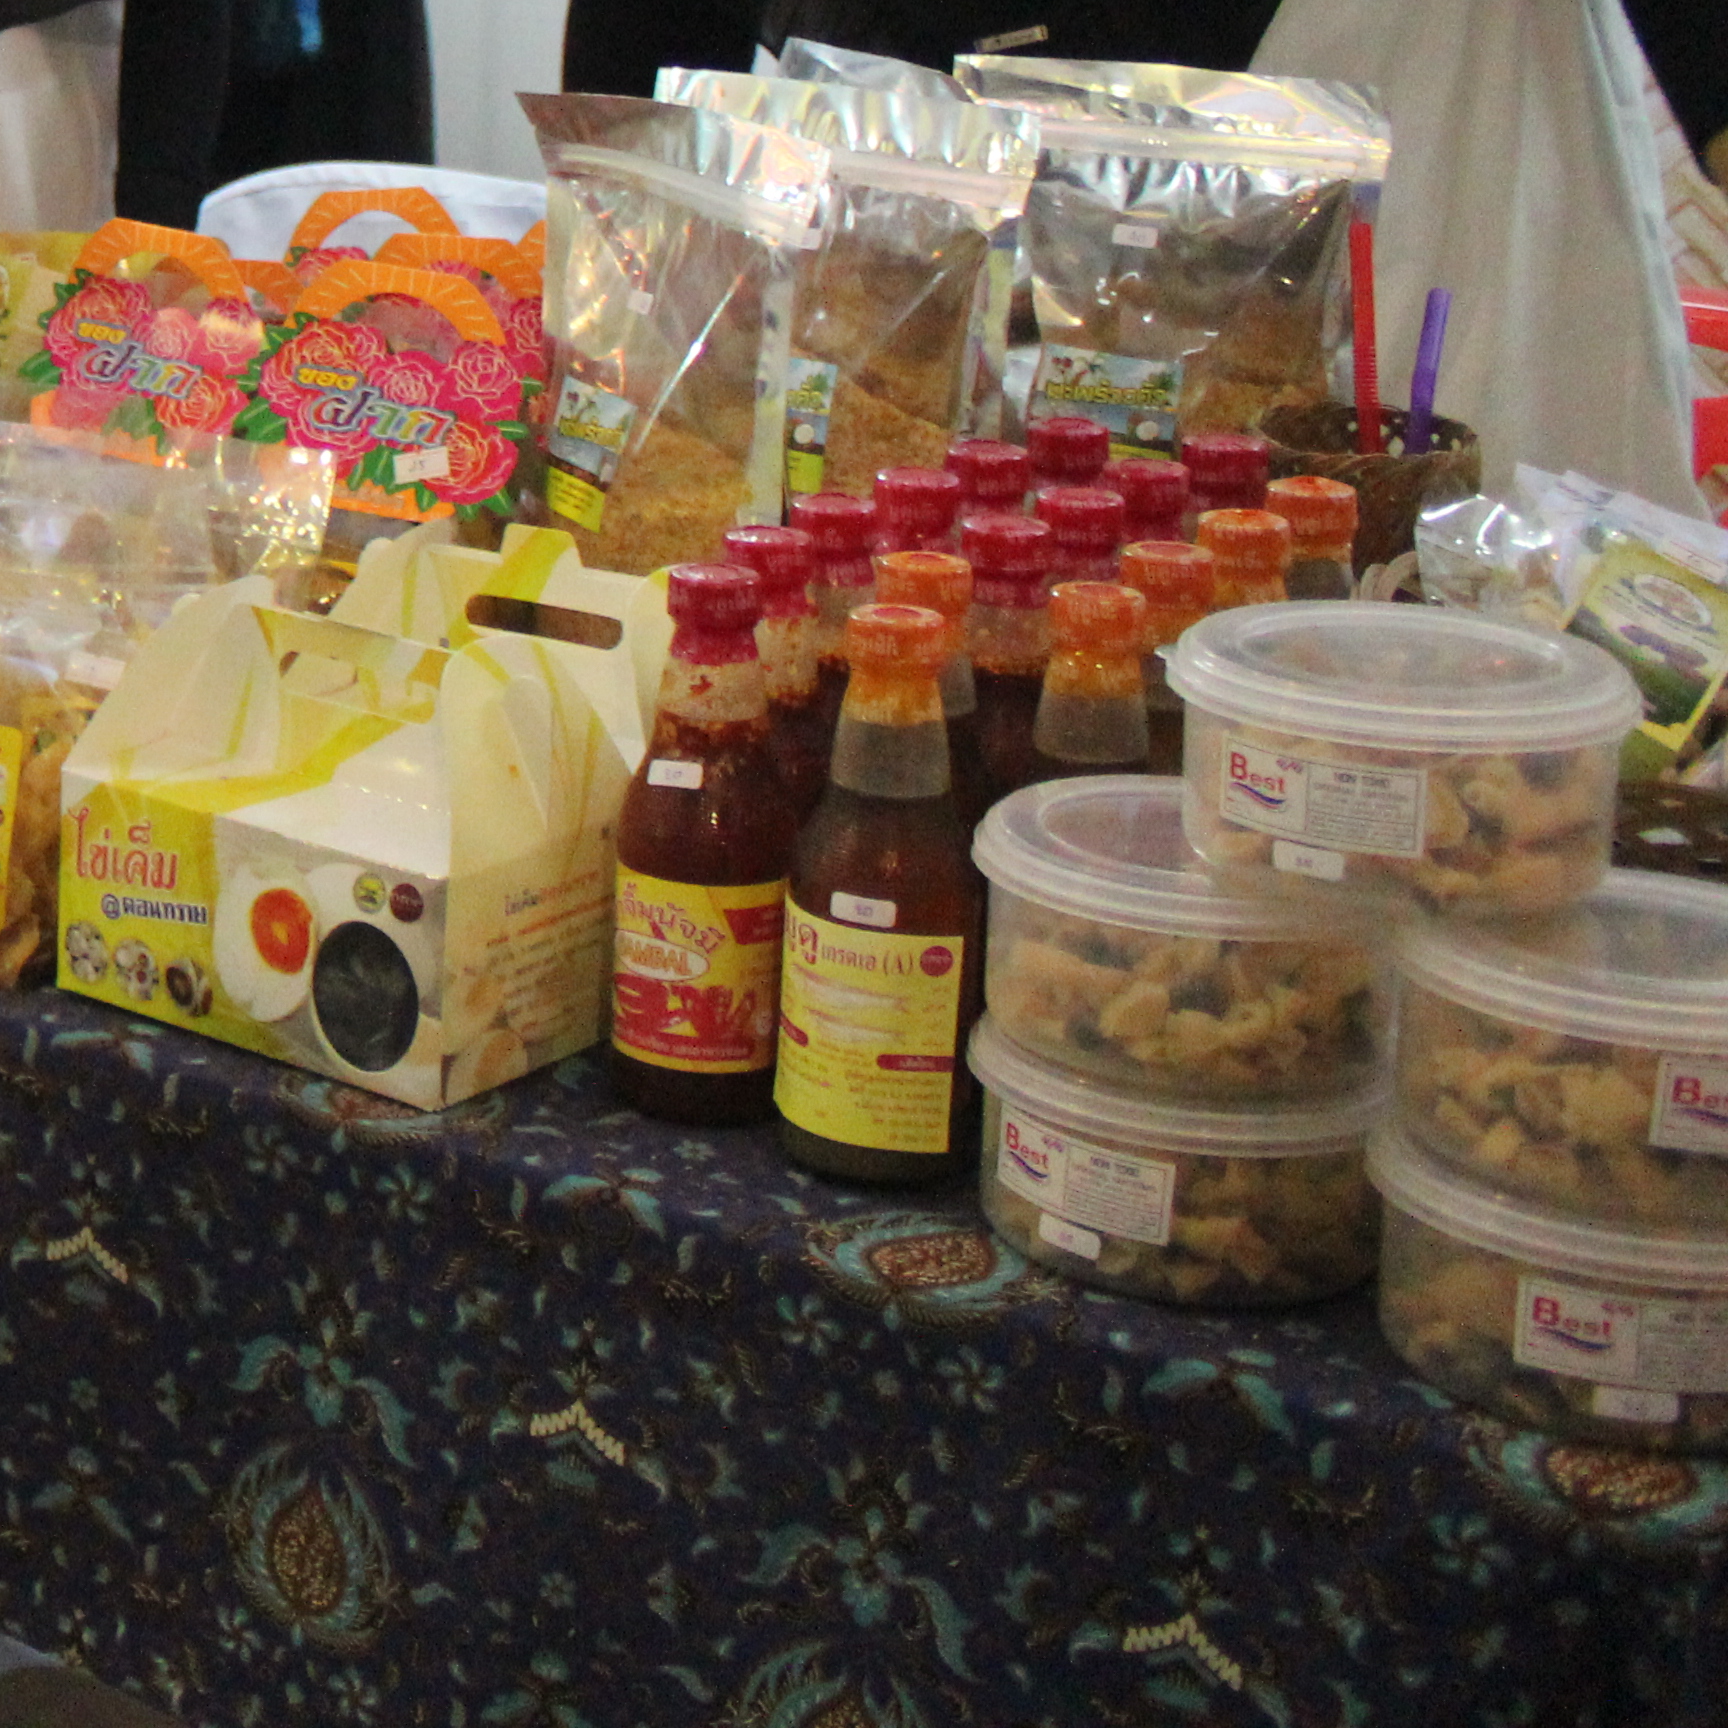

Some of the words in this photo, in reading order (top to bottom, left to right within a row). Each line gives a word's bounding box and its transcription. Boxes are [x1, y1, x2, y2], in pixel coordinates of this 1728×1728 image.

[77, 322, 126, 343] ของ
[84, 344, 200, 398] ฝาก
[296, 367, 358, 391] ของ
[311, 390, 453, 446] ฝาก
[1230, 751, 1286, 794] Best
[68, 807, 178, 889] ไข่เค็ม
[1006, 1122, 1048, 1169] Best
[1532, 1296, 1611, 1336] Best
